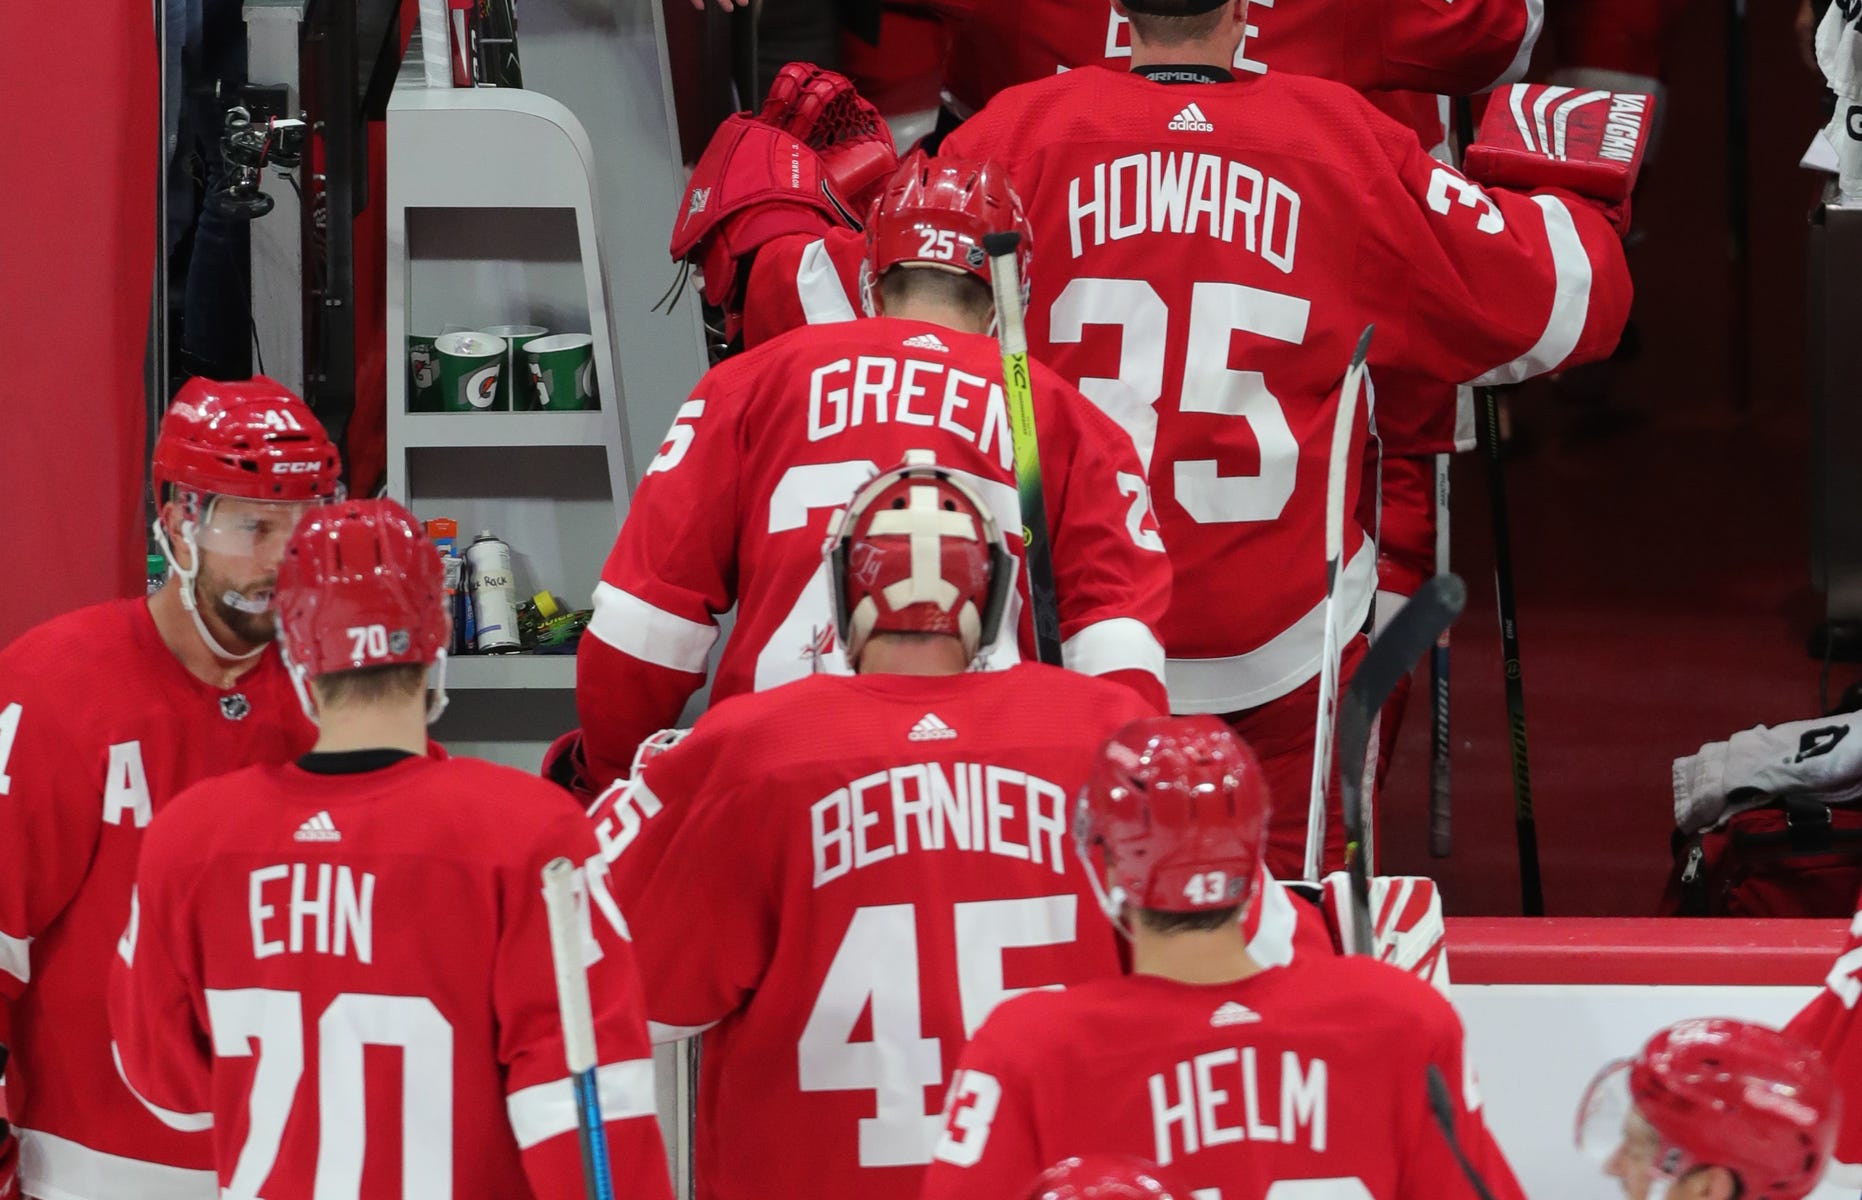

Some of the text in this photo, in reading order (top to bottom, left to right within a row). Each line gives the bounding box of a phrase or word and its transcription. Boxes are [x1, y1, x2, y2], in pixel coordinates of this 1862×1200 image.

[1168, 121, 1214, 132] adidas
[1600, 93, 1647, 164] VAUGHN
[917, 230, 954, 260] 25
[1068, 151, 1302, 275] HOWARD
[263, 409, 302, 432] 41
[807, 354, 1018, 469] GREEN
[1049, 278, 1311, 524] 35
[272, 461, 321, 474] CCM
[348, 625, 388, 659] 70
[102, 740, 153, 829] A
[811, 762, 1067, 889] BERNIER
[249, 863, 376, 964] EHN
[1184, 871, 1226, 904] 43
[205, 987, 453, 1200] 70
[1148, 1046, 1328, 1167] HELM
